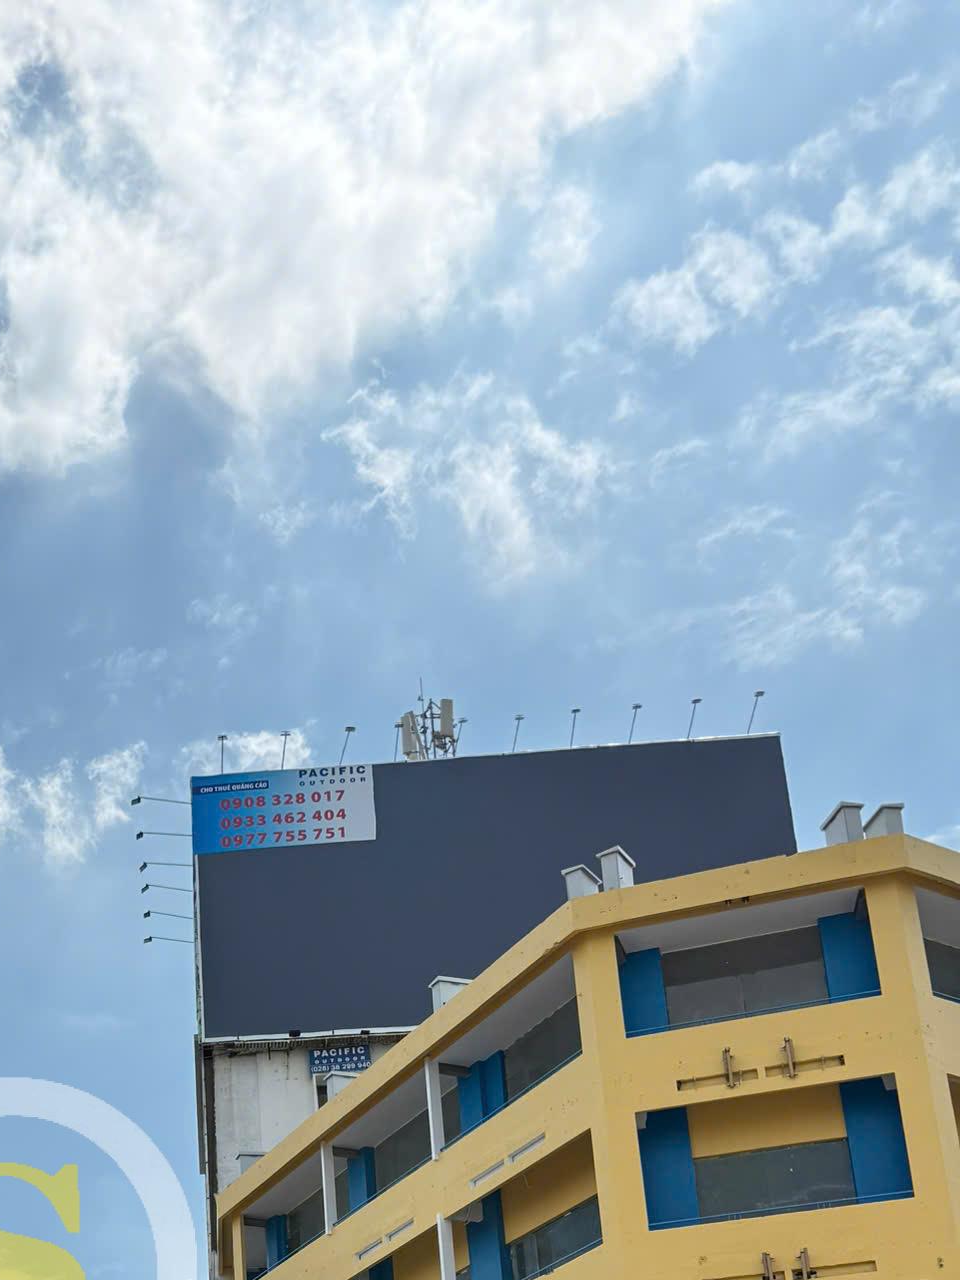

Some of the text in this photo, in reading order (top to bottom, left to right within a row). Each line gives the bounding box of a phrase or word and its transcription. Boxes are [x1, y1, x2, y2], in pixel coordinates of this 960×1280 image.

[298, 765, 366, 778] PACIFIC
[299, 777, 366, 787] OUTDOOR
[219, 789, 346, 811] 0908 328 017
[220, 808, 347, 830] 0933 462 404
[220, 826, 347, 848] 0977 755 751
[313, 1046, 365, 1058] PACIFIC
